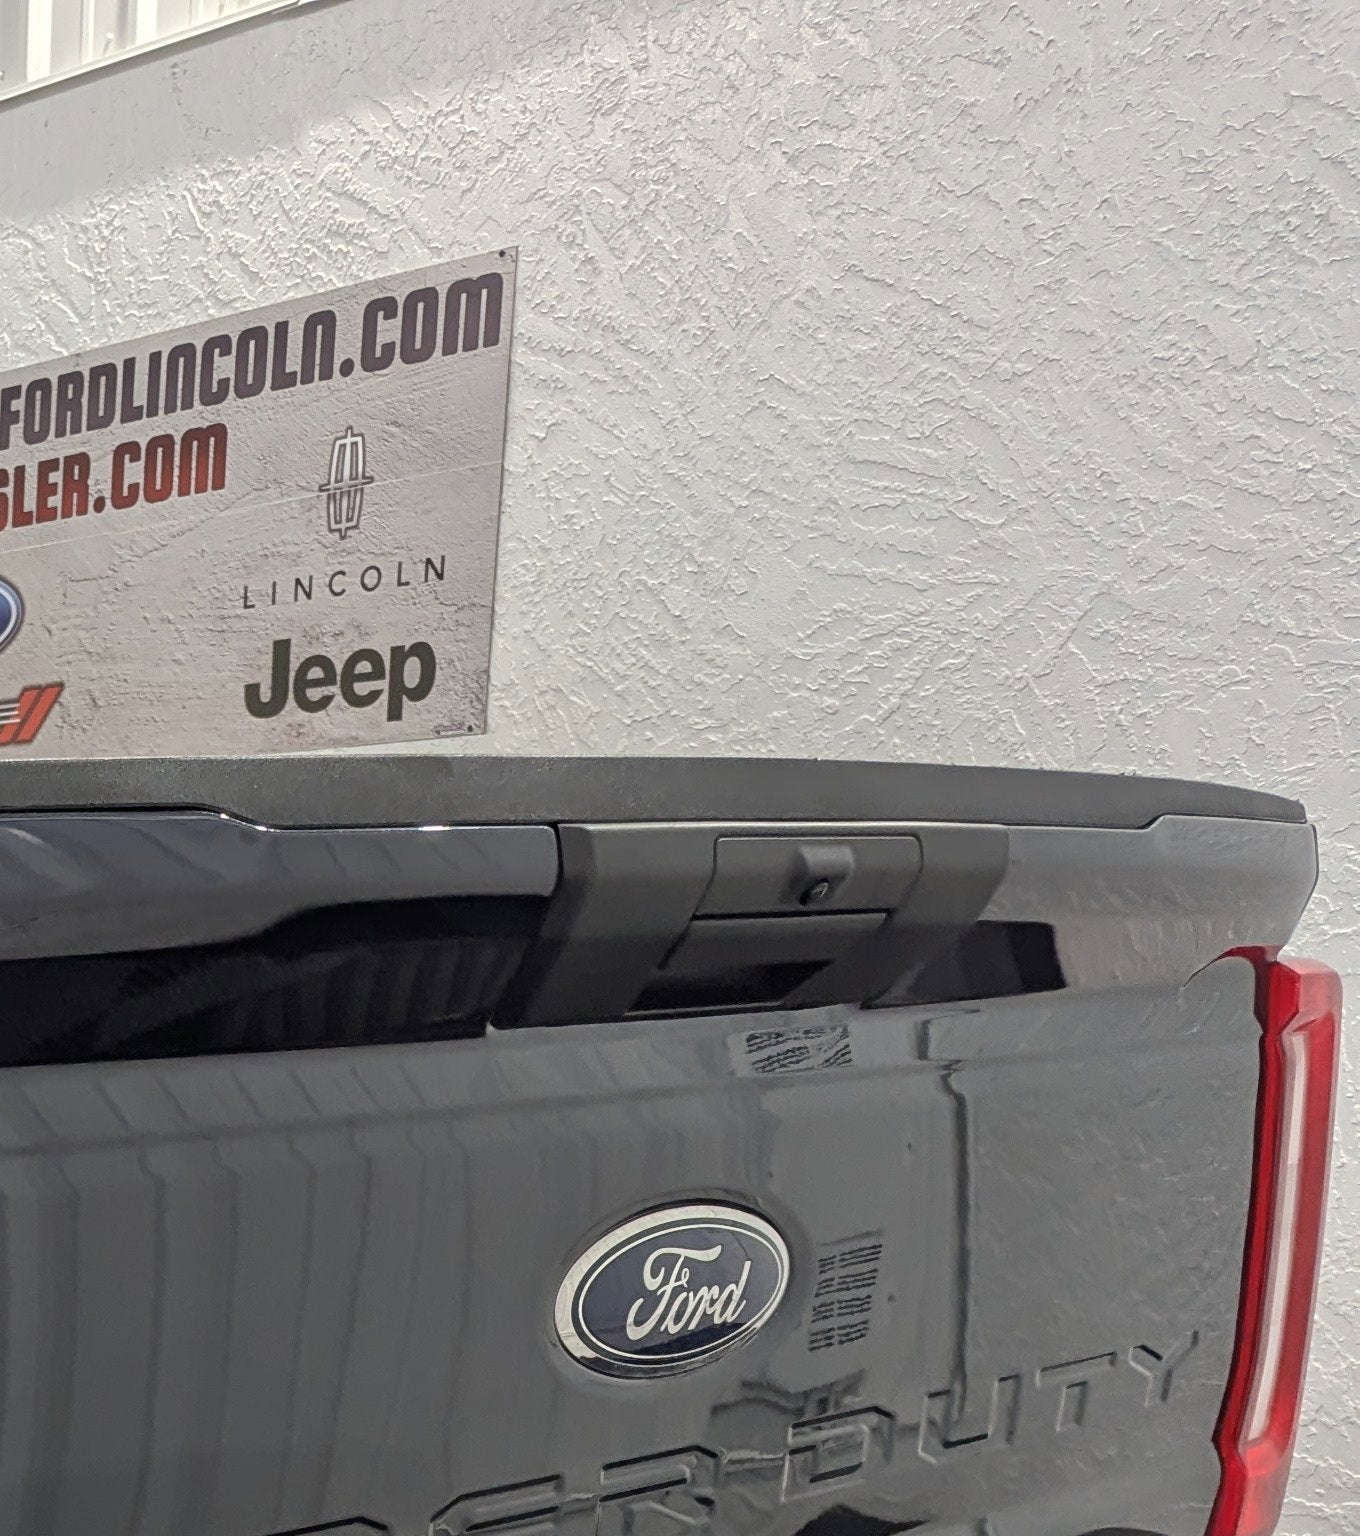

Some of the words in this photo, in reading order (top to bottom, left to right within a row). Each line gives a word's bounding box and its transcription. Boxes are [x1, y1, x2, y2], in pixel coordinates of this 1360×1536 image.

[243, 555, 446, 609] LINCOLN
[243, 638, 437, 722] Jeep
[625, 1243, 752, 1341] Ford
[780, 1329, 1202, 1504] DUTY
